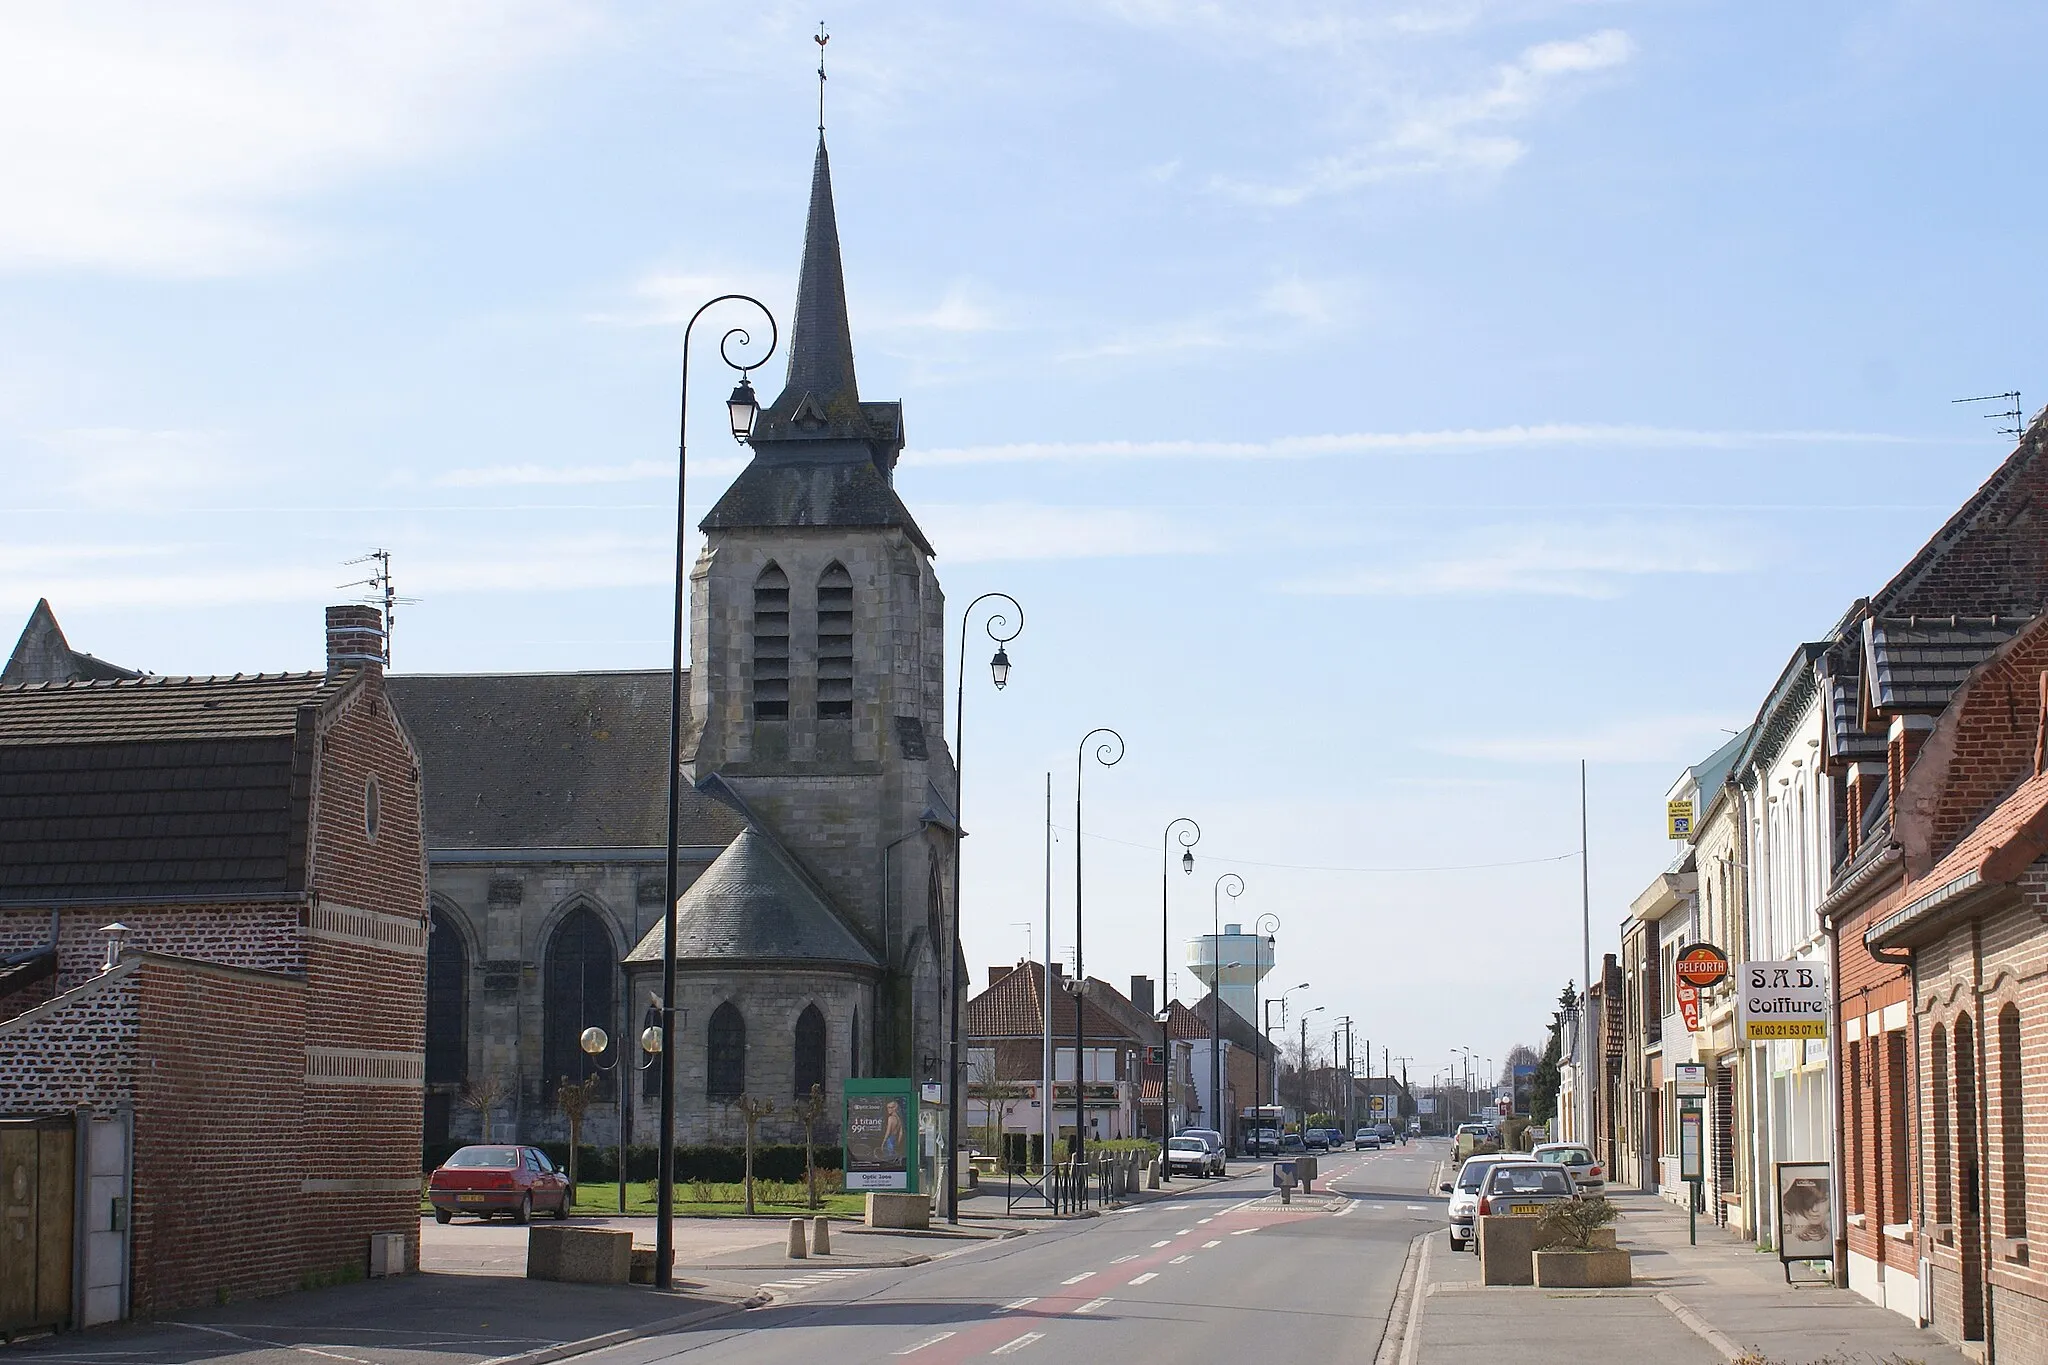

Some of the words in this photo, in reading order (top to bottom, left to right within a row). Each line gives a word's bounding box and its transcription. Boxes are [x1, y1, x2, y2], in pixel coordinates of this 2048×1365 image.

[1678, 962, 1724, 973] PELFORTH
[1751, 969, 1819, 988] S.A.B.
[1748, 998, 1822, 1013] Coiffure
[1750, 1024, 1763, 1036] Tél
[1764, 1025, 1775, 1035] 03
[1777, 1025, 1787, 1035] 21
[1789, 1025, 1800, 1035] 53
[1801, 1025, 1812, 1035] 07
[1814, 1025, 1823, 1035] 11
[860, 1117, 883, 1125] titane
